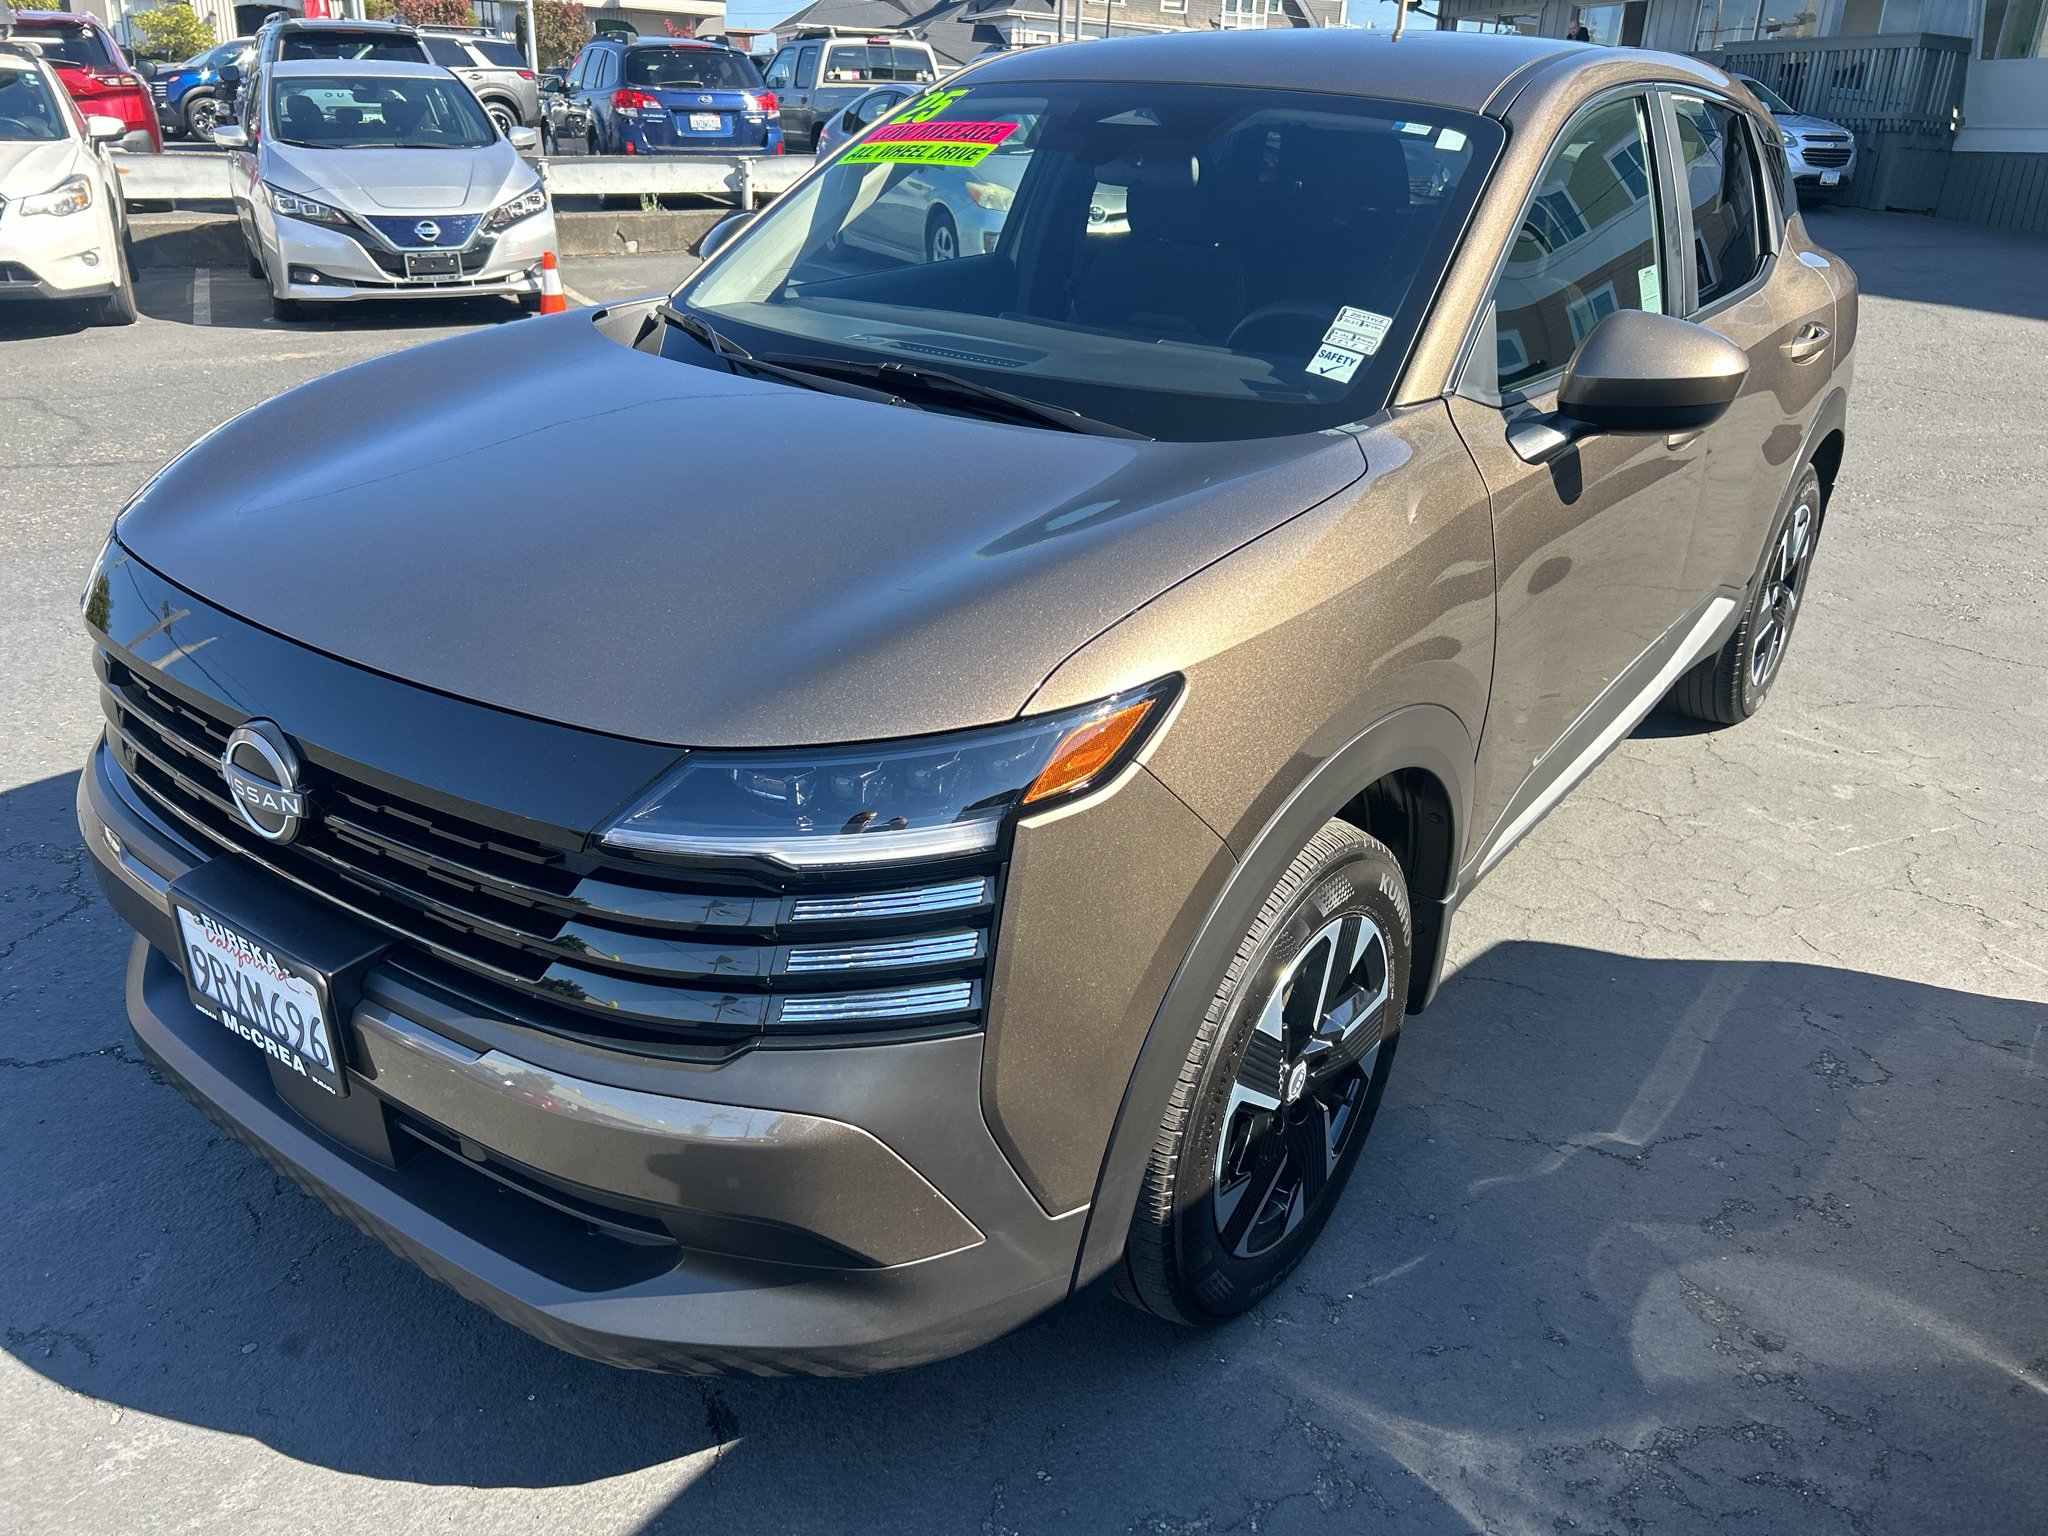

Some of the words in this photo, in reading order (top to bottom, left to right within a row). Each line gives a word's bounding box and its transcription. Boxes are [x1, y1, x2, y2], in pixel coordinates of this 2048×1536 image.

[889, 88, 970, 124] 25
[870, 125, 917, 141] LOW
[911, 124, 1006, 142] MILEAGE
[846, 145, 882, 160] ALL
[874, 144, 934, 160] WHEEL
[926, 145, 988, 162] DRIVE
[1318, 349, 1357, 367] SAFETY
[228, 773, 299, 814] ISSAN
[1378, 872, 1410, 947] KUMHO
[201, 912, 281, 972] EUREKA
[191, 944, 329, 1068] 9RXM696
